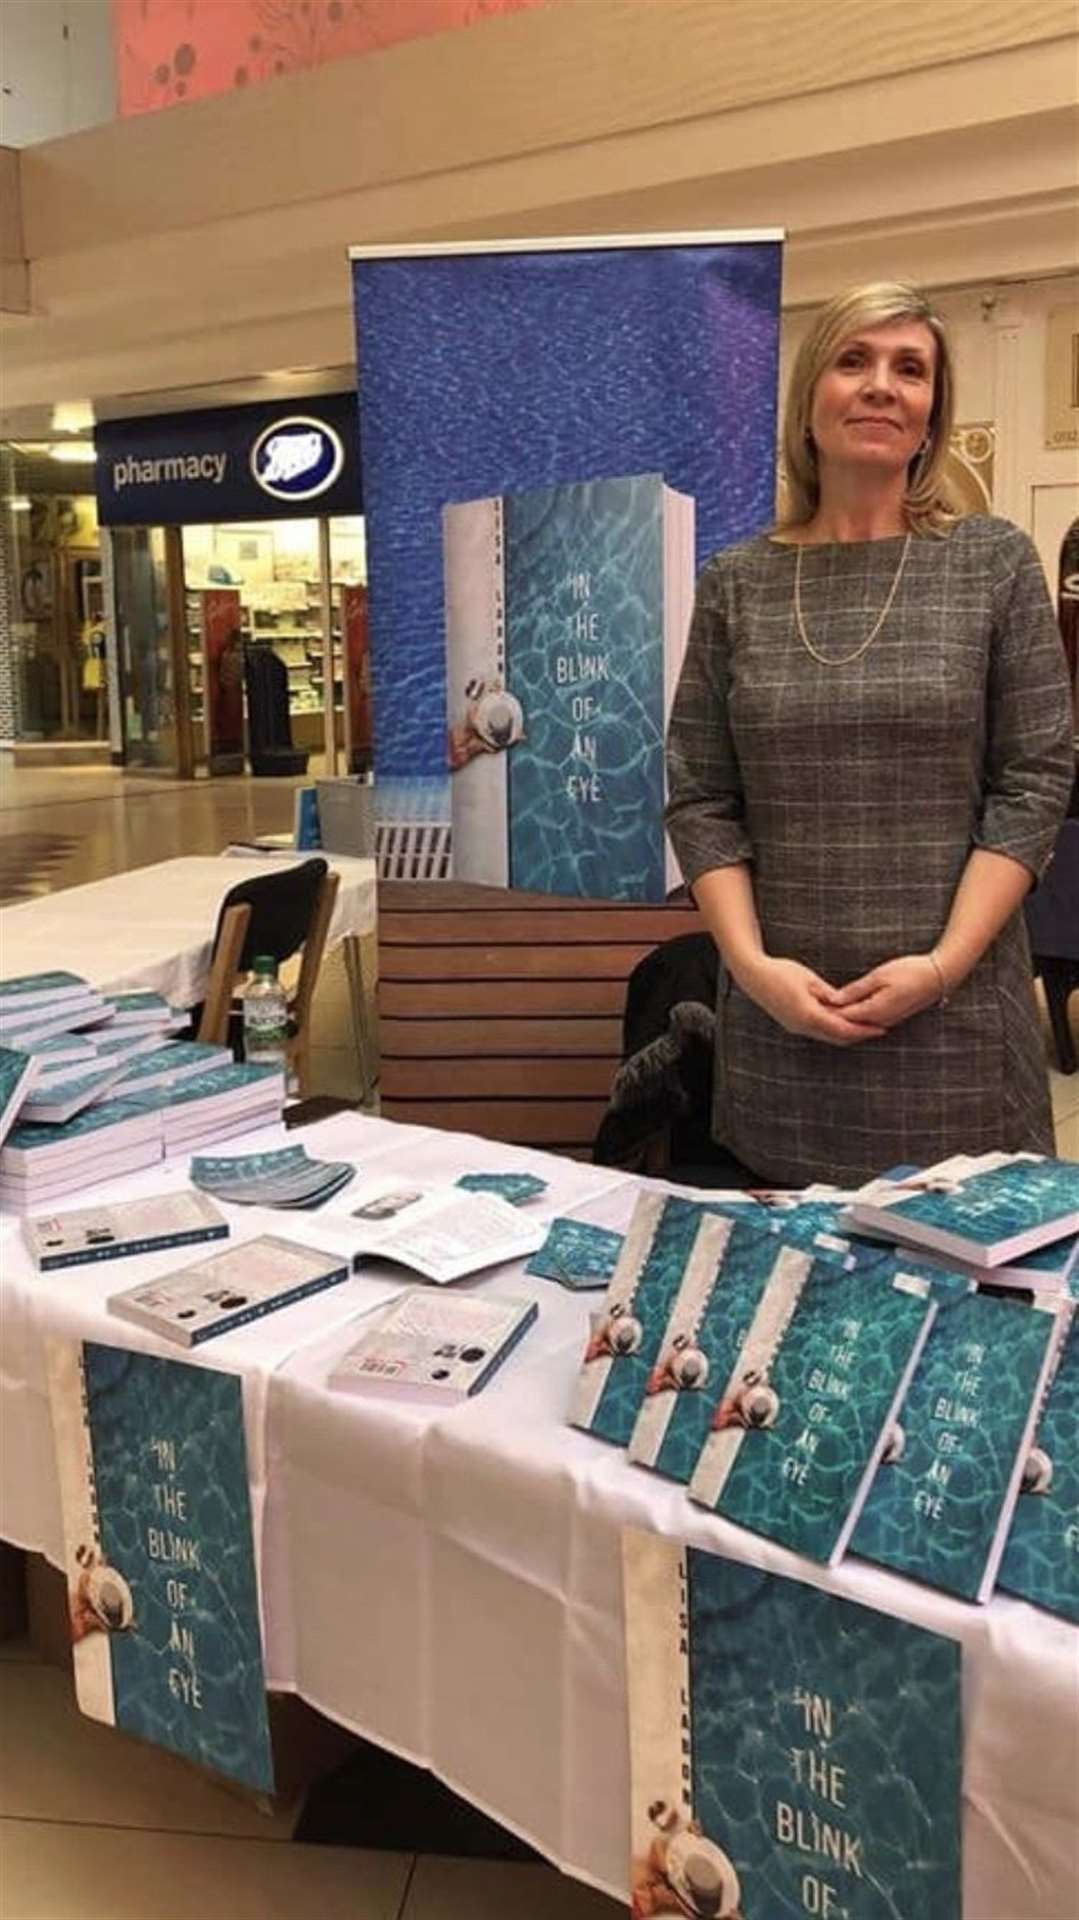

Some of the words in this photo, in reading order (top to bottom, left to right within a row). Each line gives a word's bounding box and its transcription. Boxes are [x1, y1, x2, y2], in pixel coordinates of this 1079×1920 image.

[113, 452, 227, 492] pharmacy
[556, 653, 609, 684] BLINK
[571, 697, 594, 722] OF
[153, 1484, 187, 1521] THE
[148, 1527, 201, 1571] BLINK
[166, 1579, 188, 1610] OF
[678, 1561, 687, 1655] LISA
[169, 1620, 194, 1659] AN
[804, 1692, 832, 1738] IN
[788, 1747, 847, 1809] THE
[776, 1800, 863, 1878] BLINK
[802, 1874, 837, 1920] OF
